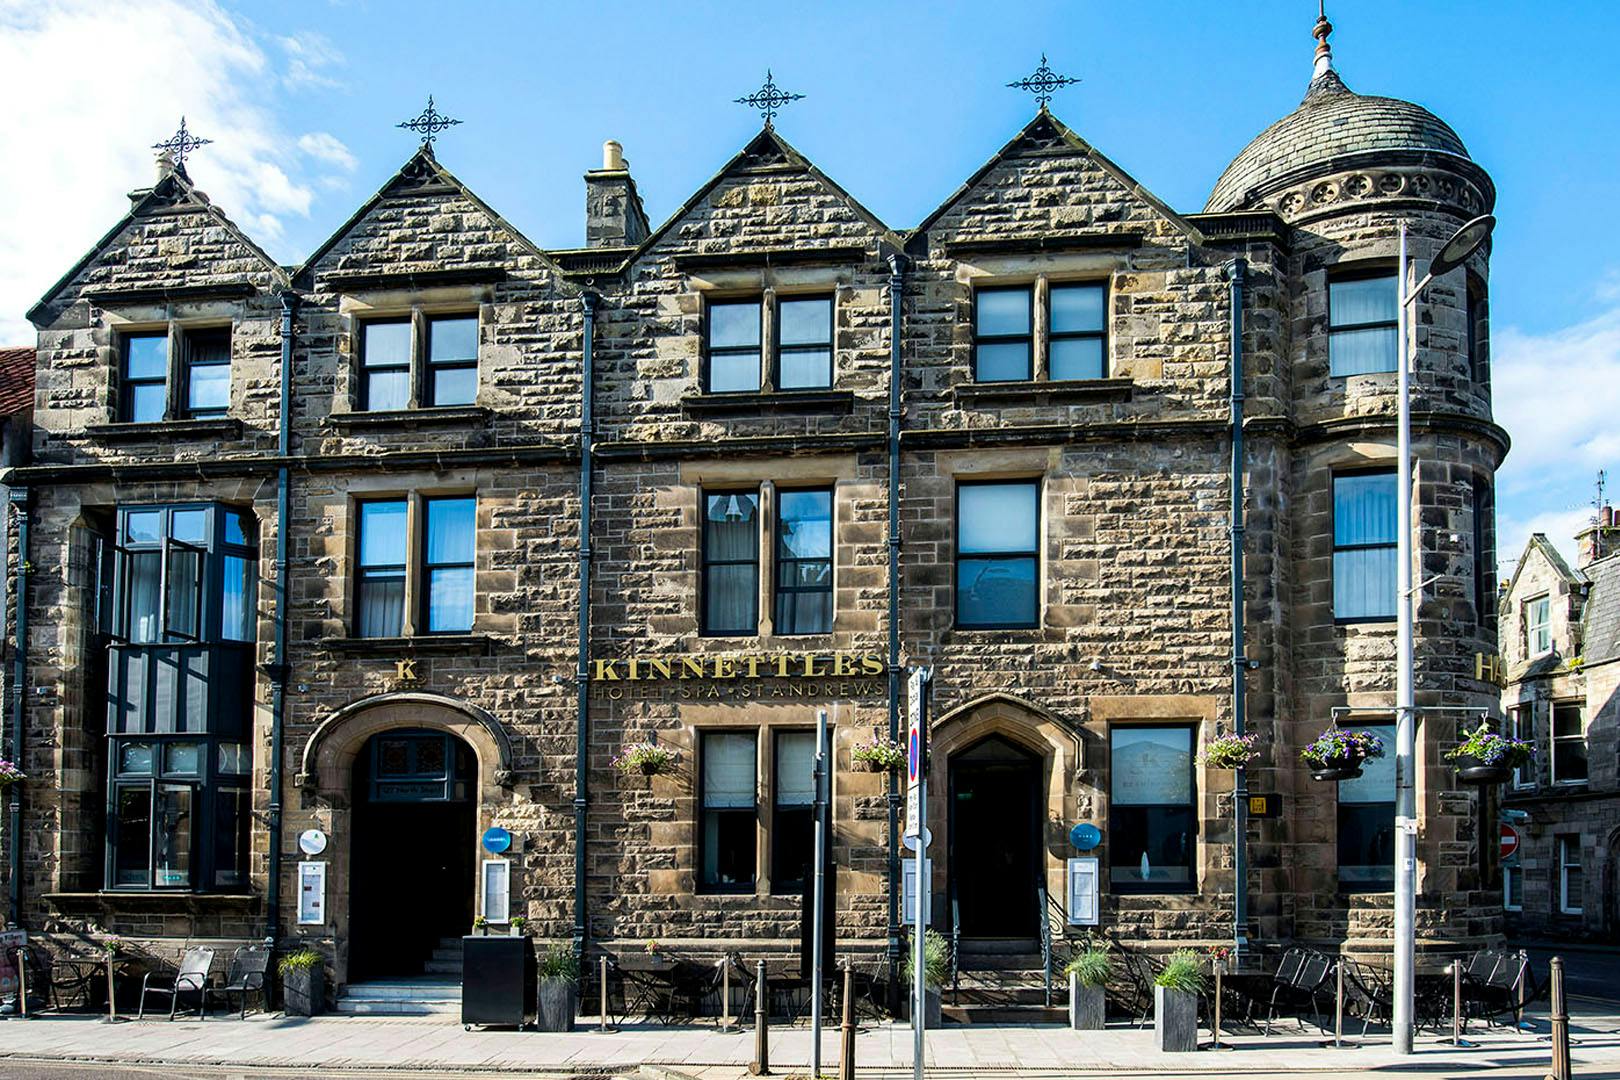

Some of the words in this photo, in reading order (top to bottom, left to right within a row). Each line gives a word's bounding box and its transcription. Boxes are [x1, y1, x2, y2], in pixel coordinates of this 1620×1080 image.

[395, 661, 417, 680] K
[592, 654, 884, 681] KINNETTLES
[594, 685, 663, 699] HOTEL
[681, 684, 720, 699] SPA
[741, 684, 764, 697] ST
[771, 682, 884, 697] ANDREWS
